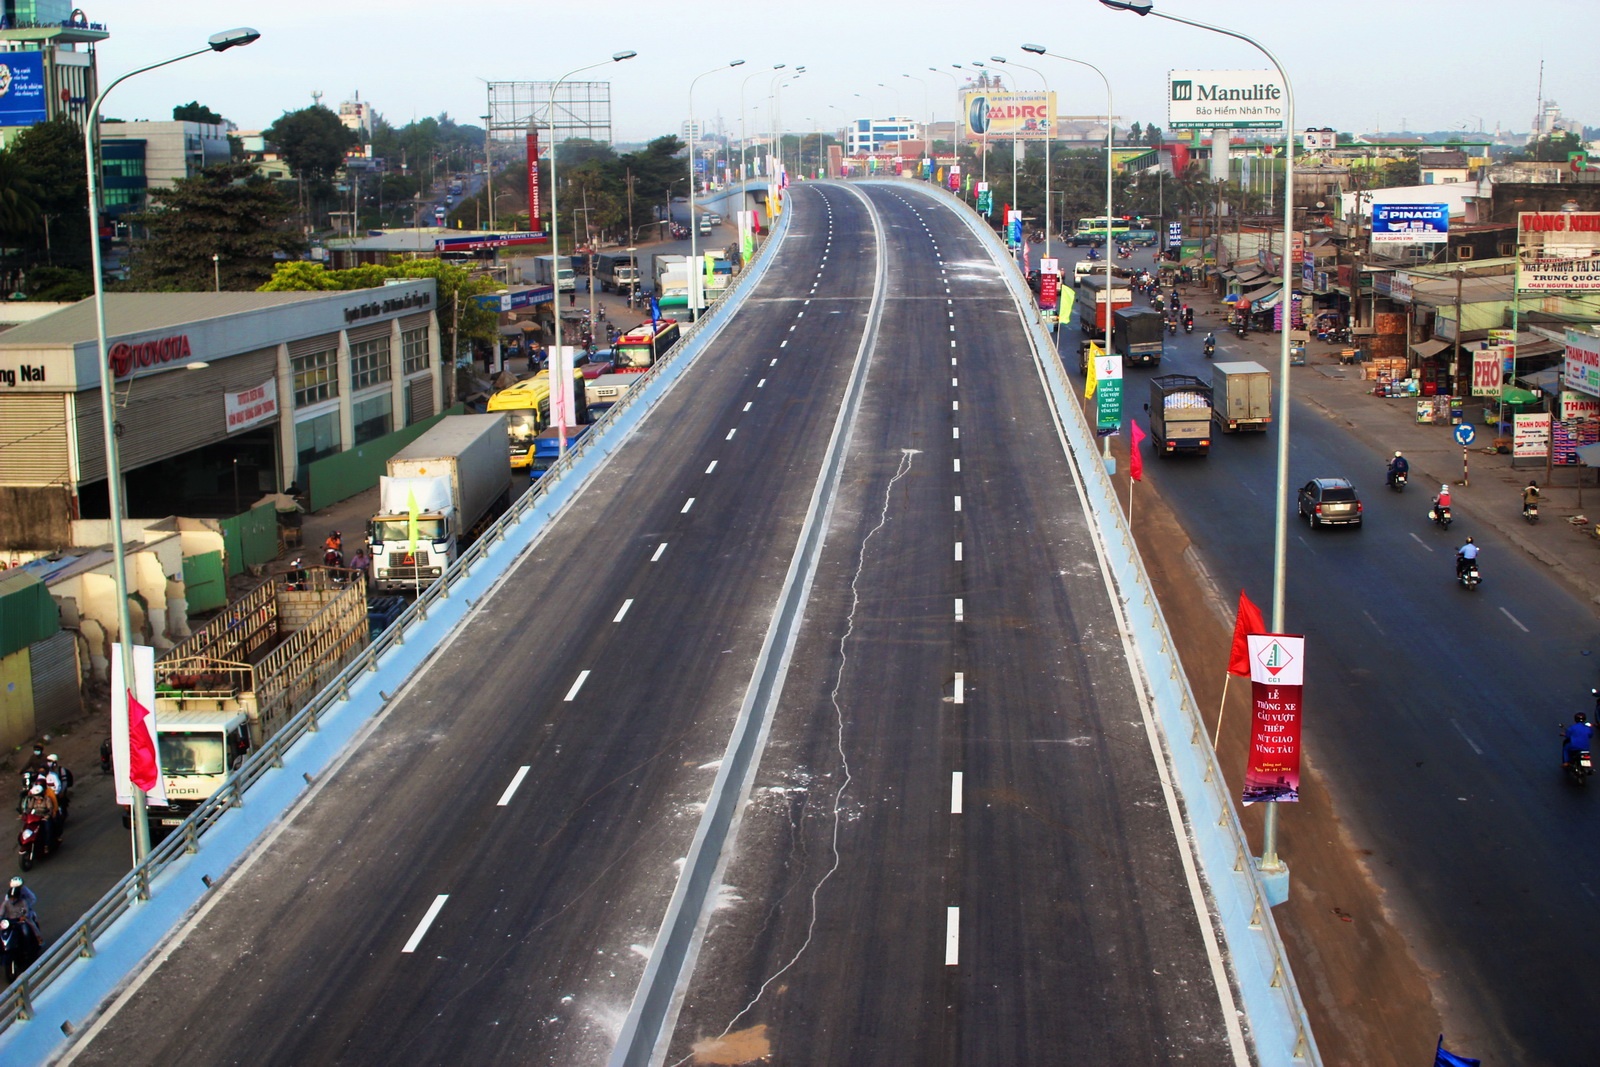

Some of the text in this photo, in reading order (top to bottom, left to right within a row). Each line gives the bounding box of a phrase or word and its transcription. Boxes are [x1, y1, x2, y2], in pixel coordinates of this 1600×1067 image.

[1197, 84, 1281, 101] Manulife
[1196, 105, 1281, 116] Bảo Hiểm Nhân Thọ
[1522, 212, 1565, 232] VÒNG
[469, 241, 508, 249] PETEC
[132, 334, 191, 368] TOYOTA
[1566, 344, 1583, 362] THANH
[20, 364, 45, 382] Nai
[1474, 351, 1500, 387] PHỞ
[1268, 689, 1280, 700] LỄ
[1257, 700, 1296, 711] THÔNG XE
[1257, 710, 1295, 722] CẦU VƯỢT
[1264, 724, 1285, 733] THÉP
[1257, 733, 1271, 743] NÚT
[1255, 744, 1294, 754] VŨNG TÀU
